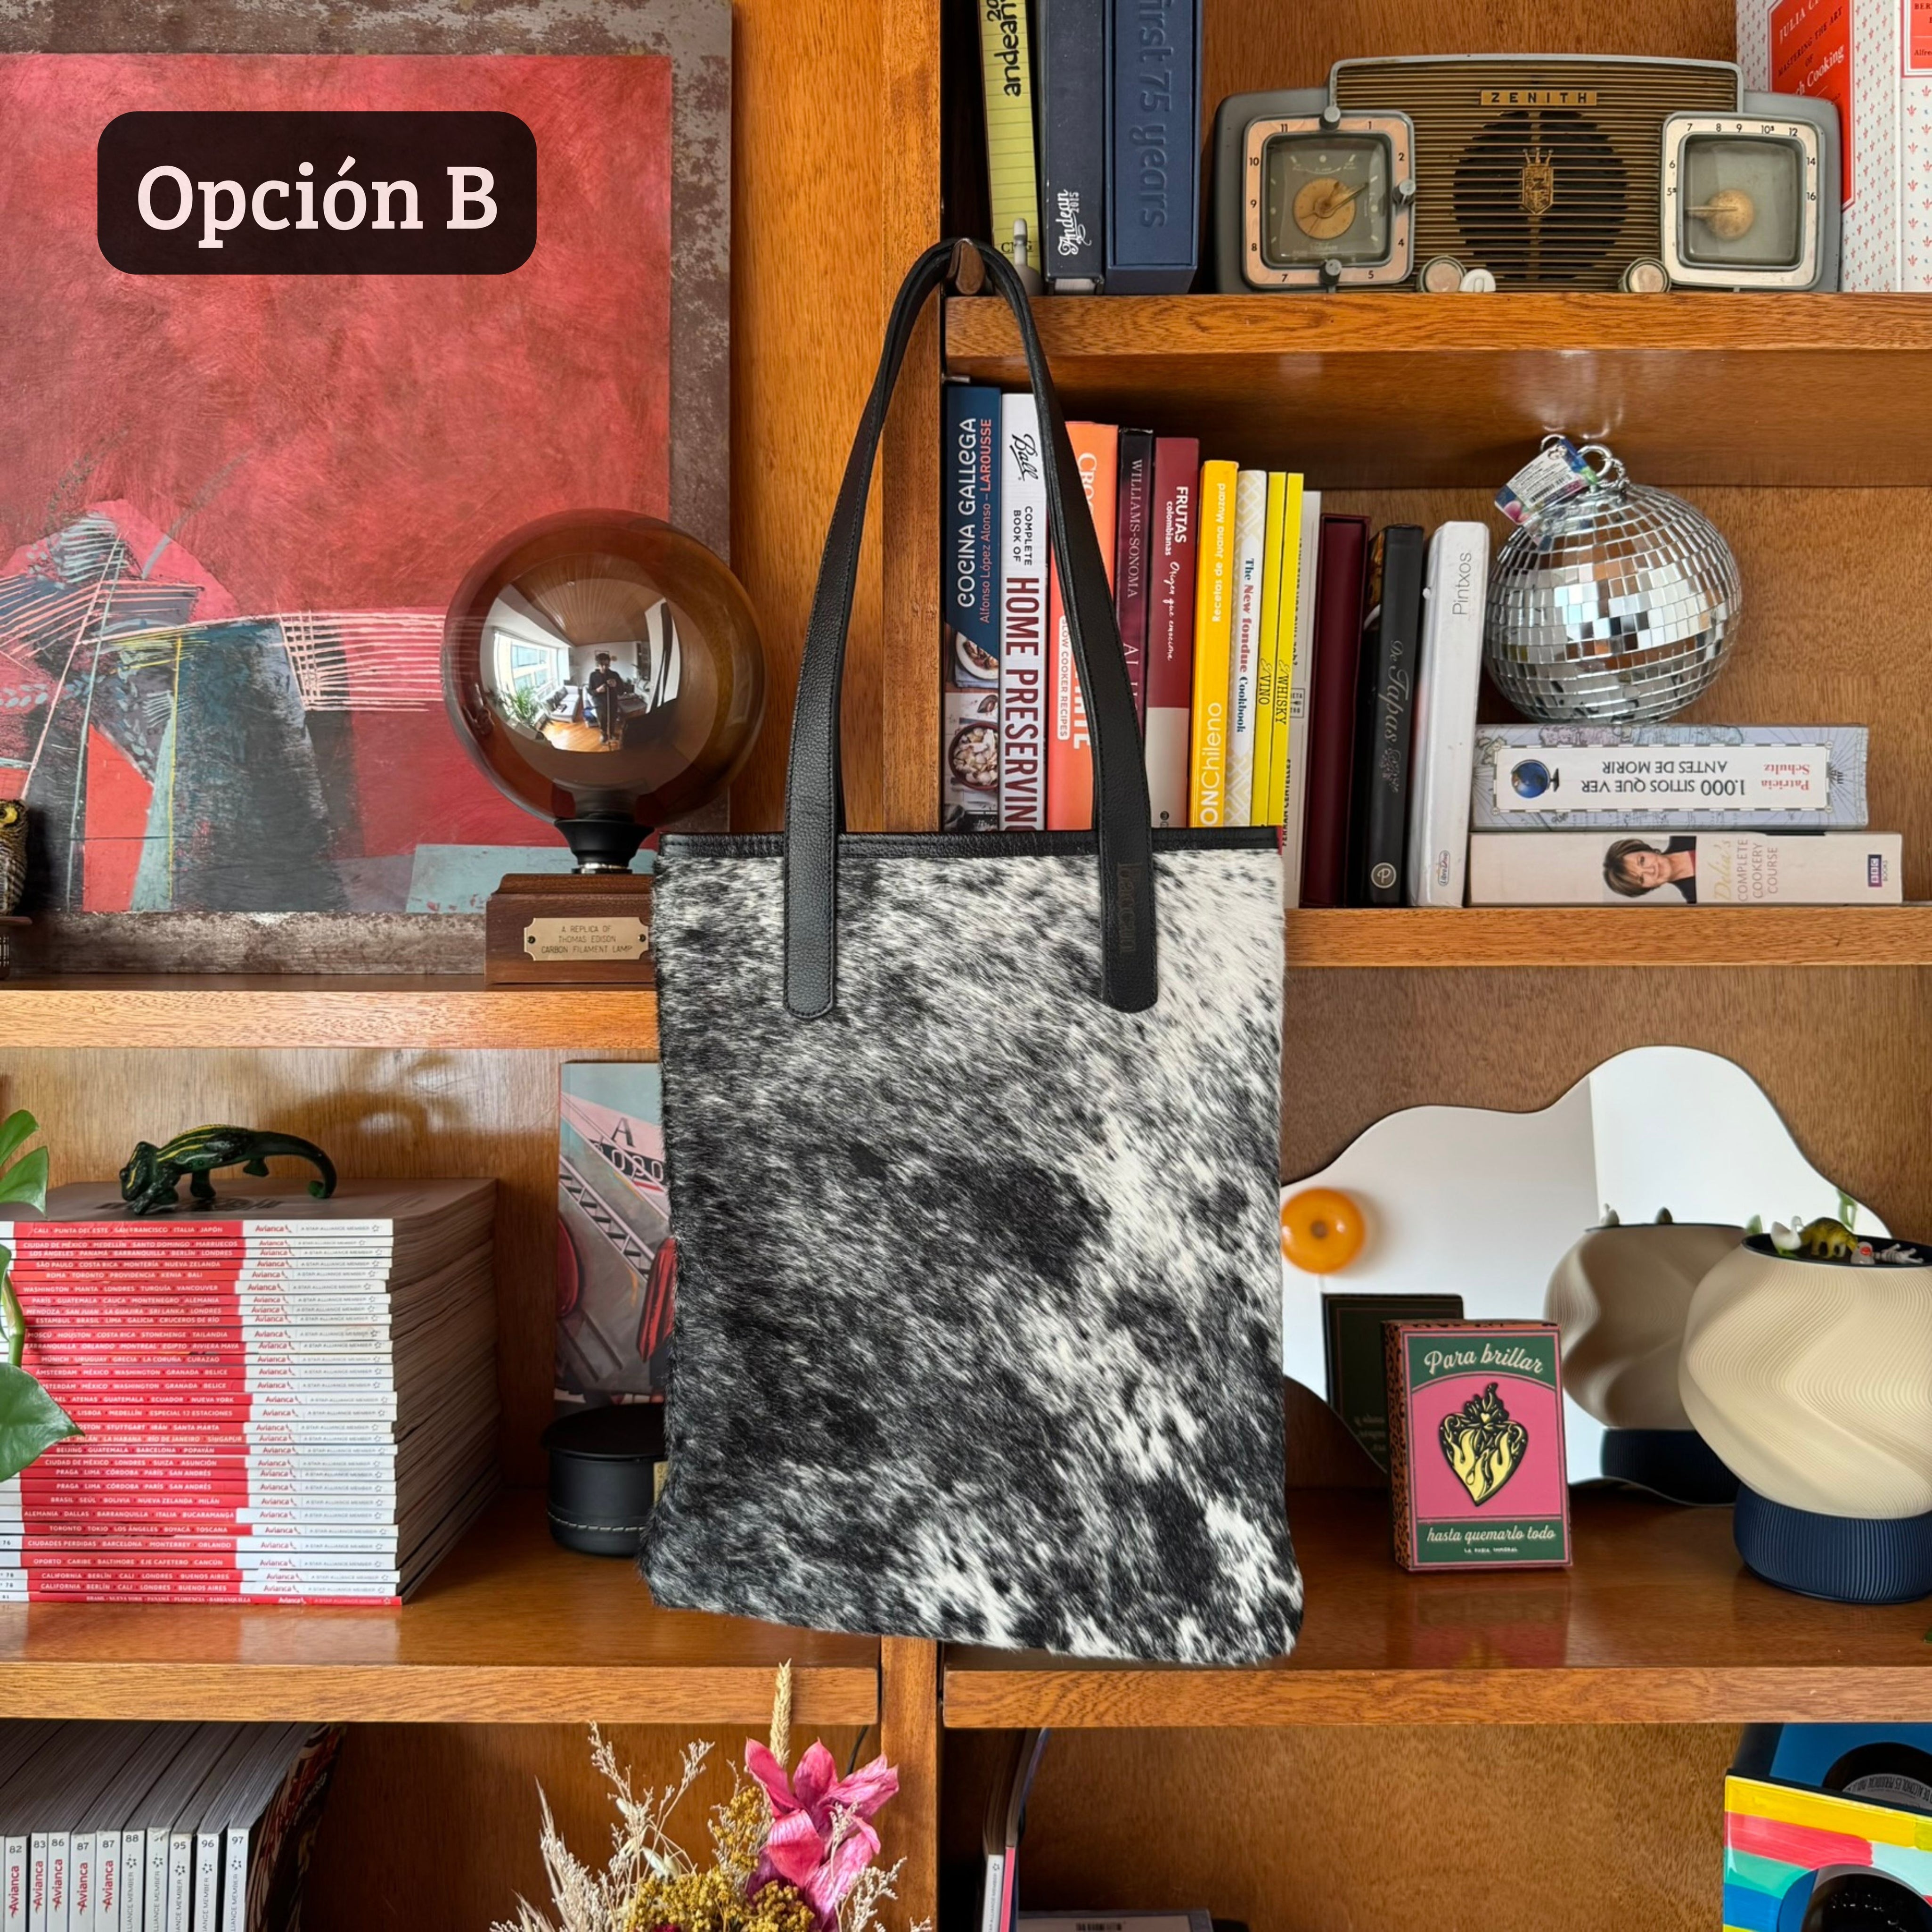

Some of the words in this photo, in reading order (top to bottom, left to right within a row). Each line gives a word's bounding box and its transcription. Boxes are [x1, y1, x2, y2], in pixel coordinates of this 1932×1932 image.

[1779, 7, 1806, 45] JULIA
[1778, 37, 1813, 78] MASTERING
[1814, 22, 1827, 41] THE
[1829, 6, 1842, 25] ART
[1807, 45, 1844, 87] Cooking
[1140, 71, 1171, 113] 75
[1491, 92, 1587, 103] ZENITH
[1280, 124, 1288, 132] 11
[1687, 123, 1693, 131] 7
[1716, 123, 1721, 132] 8
[1736, 123, 1742, 132] 9
[1789, 128, 1797, 137] 12
[1250, 157, 1260, 166] 10
[1399, 153, 1405, 161] 2
[1670, 160, 1675, 168] 6
[1807, 157, 1816, 165] 14
[1130, 125, 1169, 228] years
[1251, 200, 1257, 208] 9
[1807, 192, 1816, 201] 16
[1252, 243, 1257, 251] 8
[1398, 238, 1404, 246] 4
[1282, 275, 1288, 283] 7
[1368, 270, 1374, 278] 5
[980, 419, 992, 492] LAROUSSE
[1009, 434, 1039, 481] Ball
[1176, 486, 1188, 543] FRUTAS
[1216, 483, 1226, 523] Muzard
[980, 503, 991, 542] Alonso
[1127, 459, 1143, 598] WILLIAMS-SONOMA
[1165, 501, 1173, 556] colombianas
[1024, 506, 1033, 566] COMPLETE
[1214, 526, 1225, 558] Juana
[980, 544, 992, 579] López
[1013, 545, 1021, 562] OF
[957, 524, 975, 608] COCINA
[1215, 562, 1223, 576] de
[1244, 558, 1254, 581] The
[1452, 552, 1472, 615] Pintxos
[980, 581, 991, 623] Alfonso
[1212, 581, 1222, 622] Recetas
[1243, 584, 1254, 614] New
[1005, 578, 1040, 655] HOME
[1060, 652, 1069, 693] COOKER
[1258, 674, 1272, 705] VINO
[1276, 674, 1289, 725] WHISKY
[1237, 676, 1248, 733] Cookbook
[1059, 696, 1068, 737] RECIPES
[1005, 669, 1039, 831] PRESERVIN
[1603, 761, 1650, 774] MORIR
[1654, 761, 1674, 774] DE
[1679, 761, 1727, 774] ANTES
[1764, 763, 1810, 775] Schultz
[1581, 780, 1611, 793] VER
[1615, 777, 1646, 793] QUE
[1650, 779, 1695, 793] SITIOS
[1701, 779, 1745, 796] 1.000
[1761, 779, 1809, 791] Patricia
[1737, 839, 1748, 902] COMPLETE
[1752, 843, 1763, 899] COOKERY
[1767, 847, 1778, 894] COURSE
[1870, 858, 1879, 883] BBC
[1424, 1349, 1476, 1375] Para
[1480, 1343, 1543, 1374] brillar
[1427, 1527, 1461, 1542] hasta
[1465, 1527, 1524, 1545] quemarlo
[1527, 1525, 1556, 1540] todo
[9, 1845, 22, 1853] 82
[33, 1840, 46, 1848] 83
[51, 1839, 65, 1847] 86
[77, 1842, 89, 1851] 87
[102, 1840, 115, 1848] 87
[125, 1834, 139, 1843] 88
[173, 1842, 187, 1850] 95
[201, 1840, 214, 1848] 96
[232, 1836, 244, 1845] 97
[8, 1865, 20, 1913] Avianca
[34, 1860, 44, 1908] Avianca
[53, 1858, 63, 1908] Avianca
[79, 1862, 88, 1911] Avianca
[104, 1859, 114, 1908] Avianca
